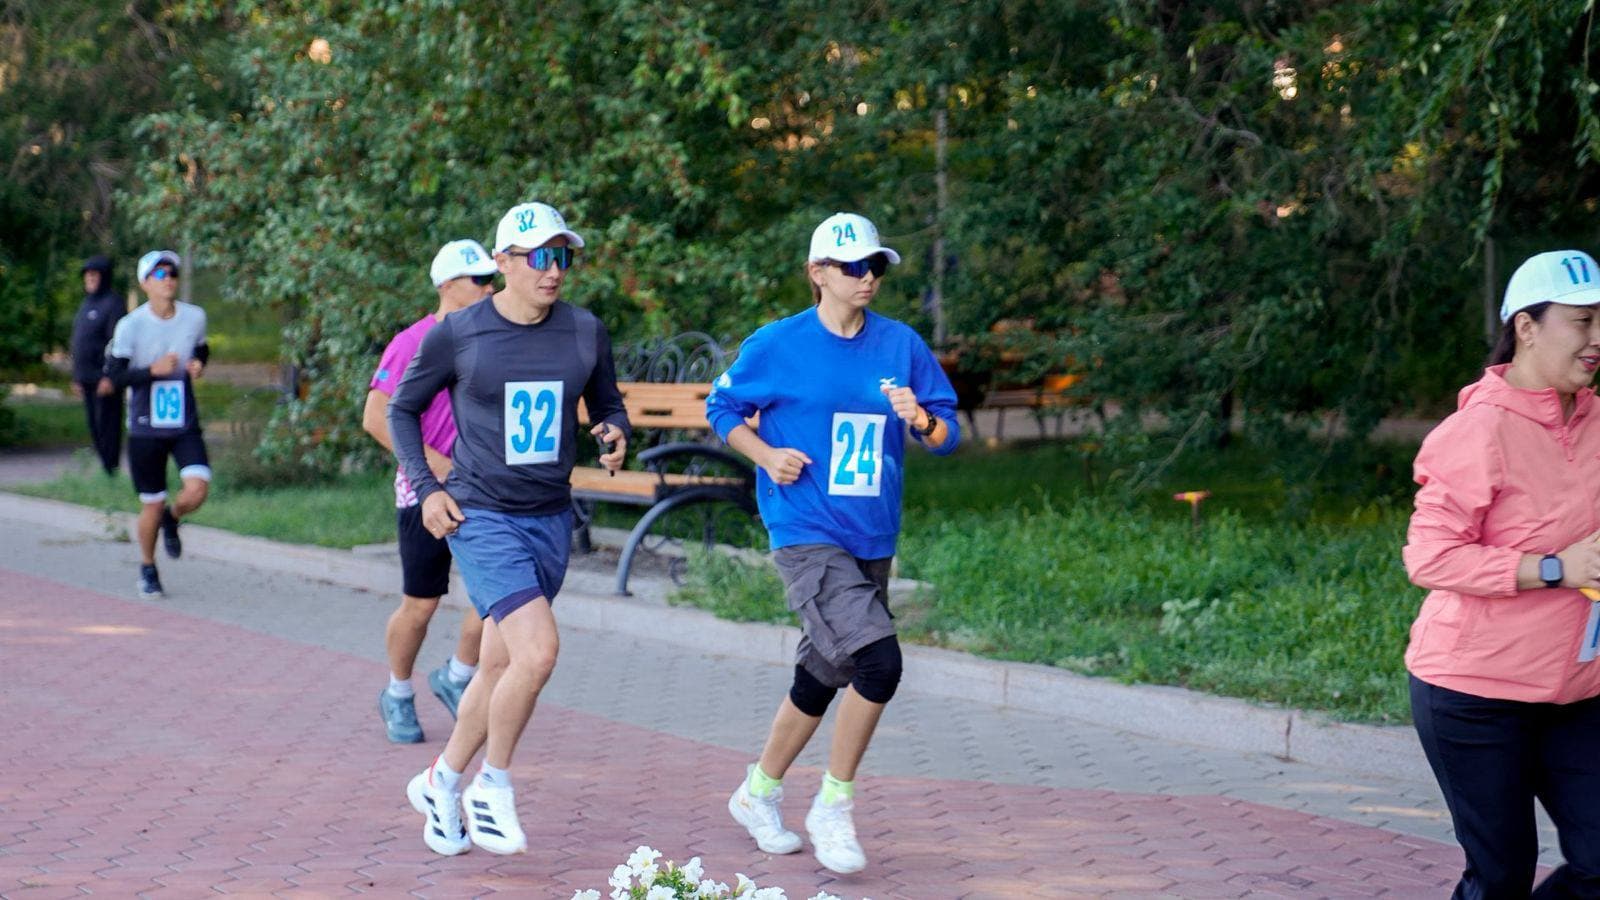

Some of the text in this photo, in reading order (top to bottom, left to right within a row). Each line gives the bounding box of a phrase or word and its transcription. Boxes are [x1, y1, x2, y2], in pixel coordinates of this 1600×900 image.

[515, 210, 537, 232] 32
[832, 222, 856, 246] 24
[1561, 257, 1591, 285] 17
[156, 386, 180, 419] 09
[511, 389, 556, 453] 32
[834, 421, 876, 486] 24
